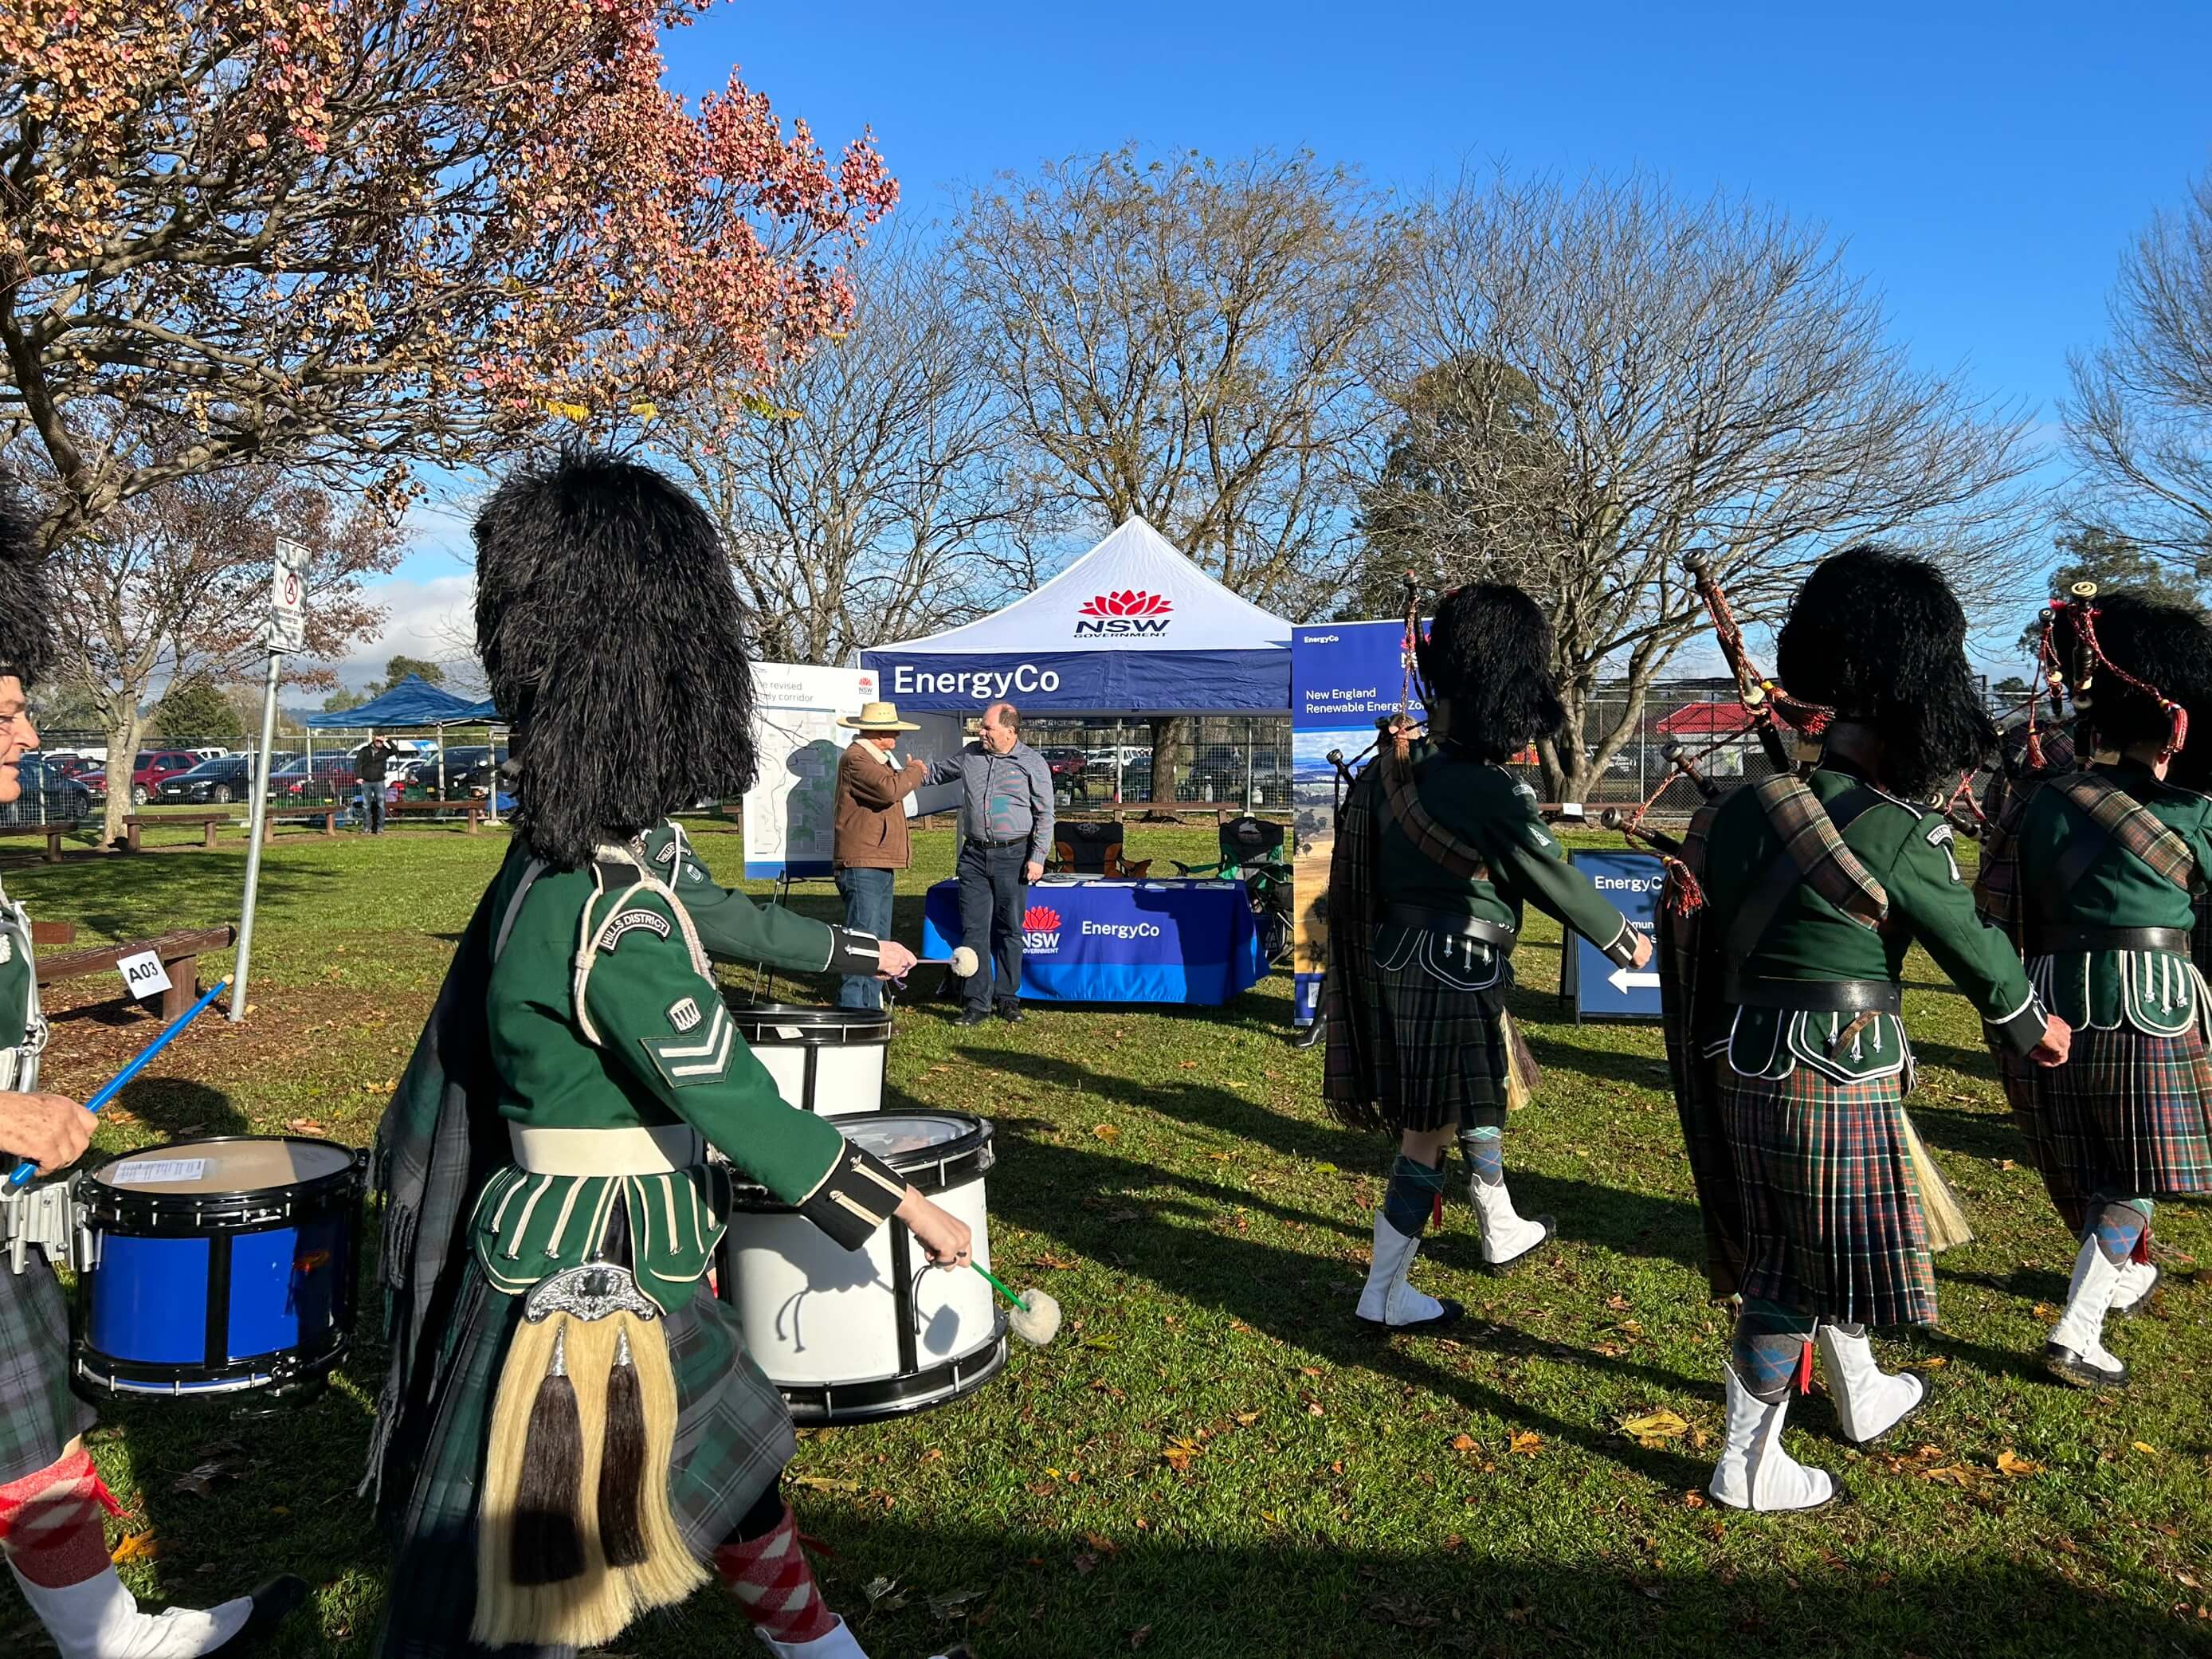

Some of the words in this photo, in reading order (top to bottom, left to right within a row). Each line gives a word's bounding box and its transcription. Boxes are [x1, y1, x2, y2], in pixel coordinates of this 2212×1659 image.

[1076, 619, 1171, 633] NSW
[1304, 635, 1339, 644] EnergyCo
[771, 682, 802, 691] revised
[894, 665, 1059, 699] EnergyCo
[779, 693, 814, 703] corridor
[1306, 690, 1329, 700] New
[1332, 688, 1376, 700] England
[1306, 702, 1365, 714] Renewable
[1594, 876, 1662, 892] EnergyC
[602, 920, 624, 945] HILLS
[623, 914, 666, 930] DISTRICT
[1082, 920, 1159, 939] EnergyCo
[128, 961, 159, 983] A03
